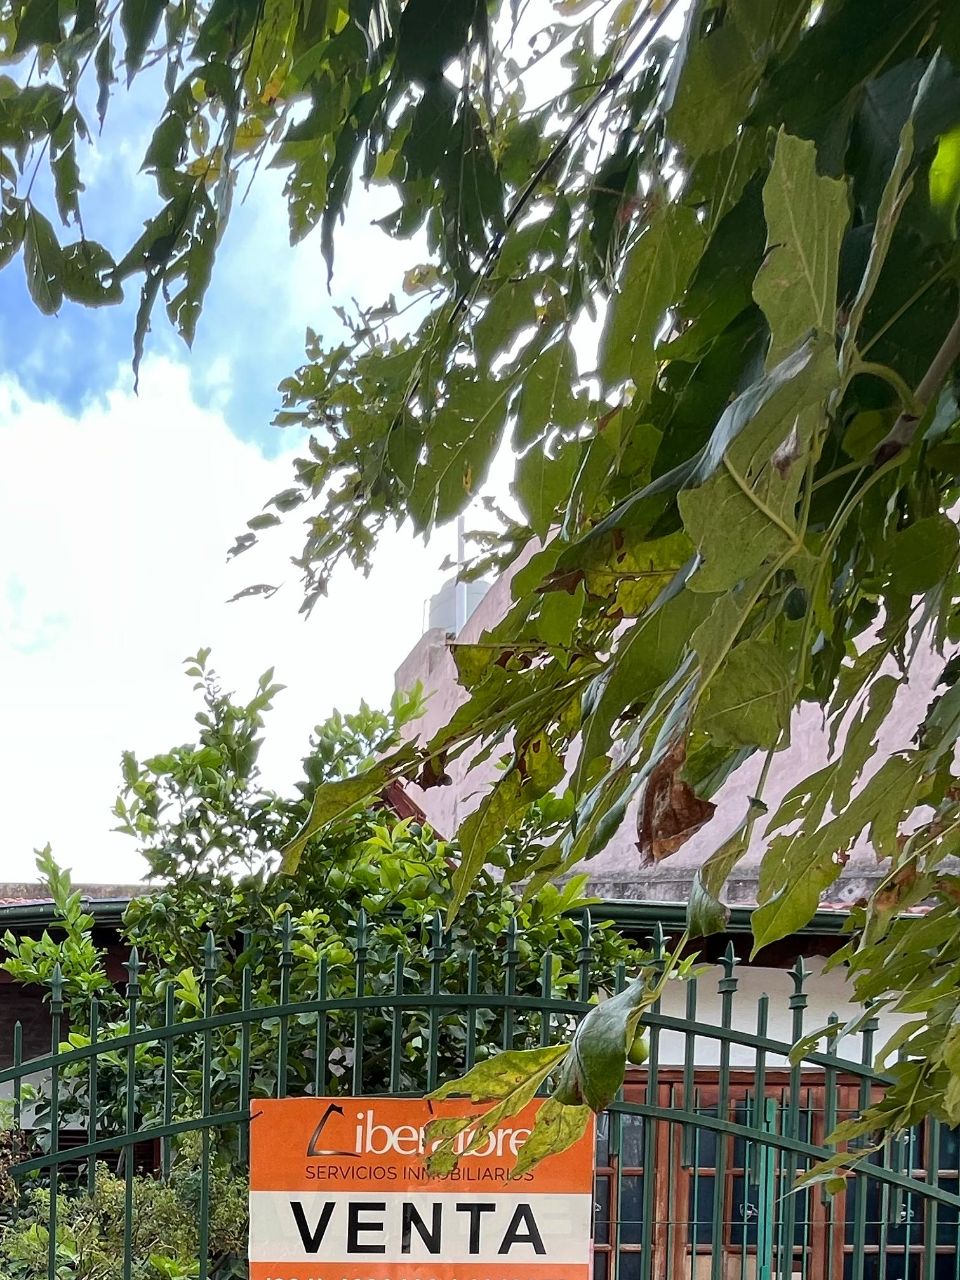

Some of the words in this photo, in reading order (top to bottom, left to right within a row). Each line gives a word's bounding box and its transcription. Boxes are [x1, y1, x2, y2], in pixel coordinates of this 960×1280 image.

[305, 1165, 398, 1181] SERVICIOS
[403, 1166, 535, 1183] INBILIARIS
[290, 1201, 547, 1255] VENTA
